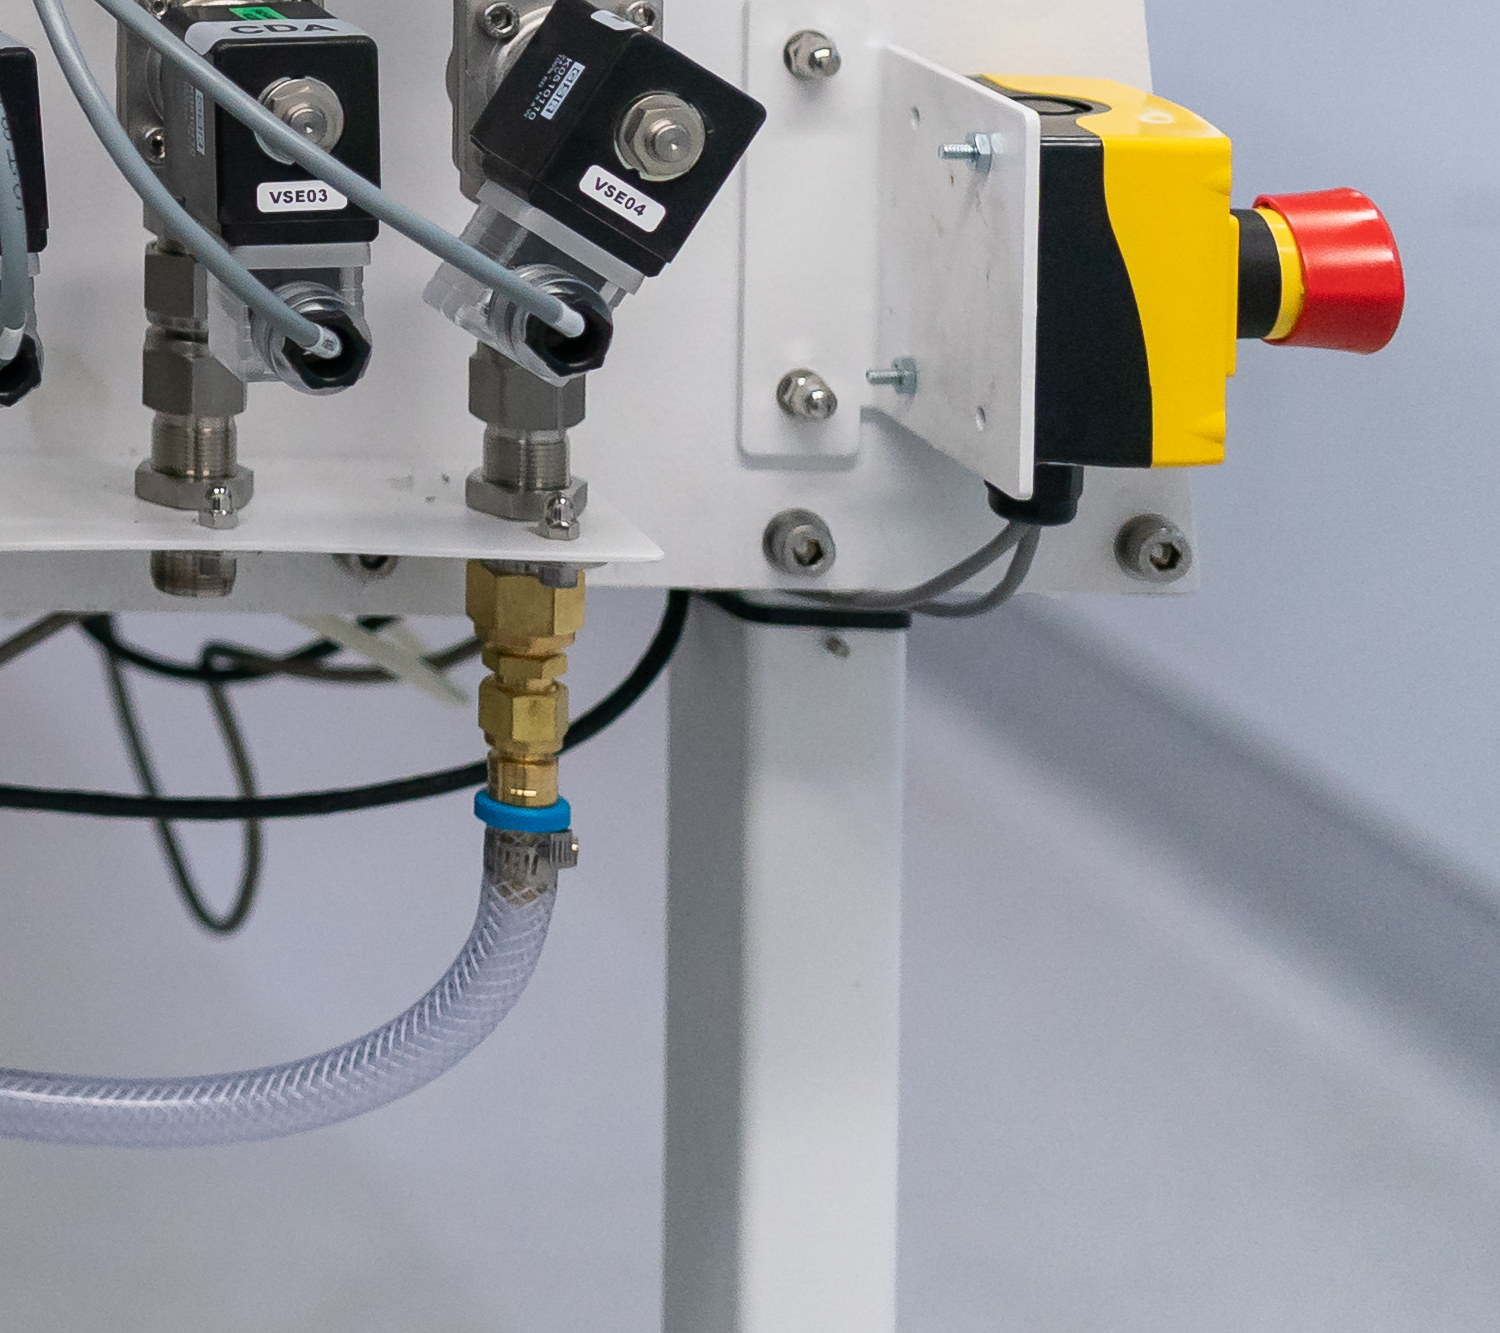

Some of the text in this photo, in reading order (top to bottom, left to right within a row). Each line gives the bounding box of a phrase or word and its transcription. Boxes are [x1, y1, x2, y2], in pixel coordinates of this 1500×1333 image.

[230, 24, 339, 34] CDA
[269, 189, 328, 204] VSE03
[594, 177, 647, 216] VSE04
